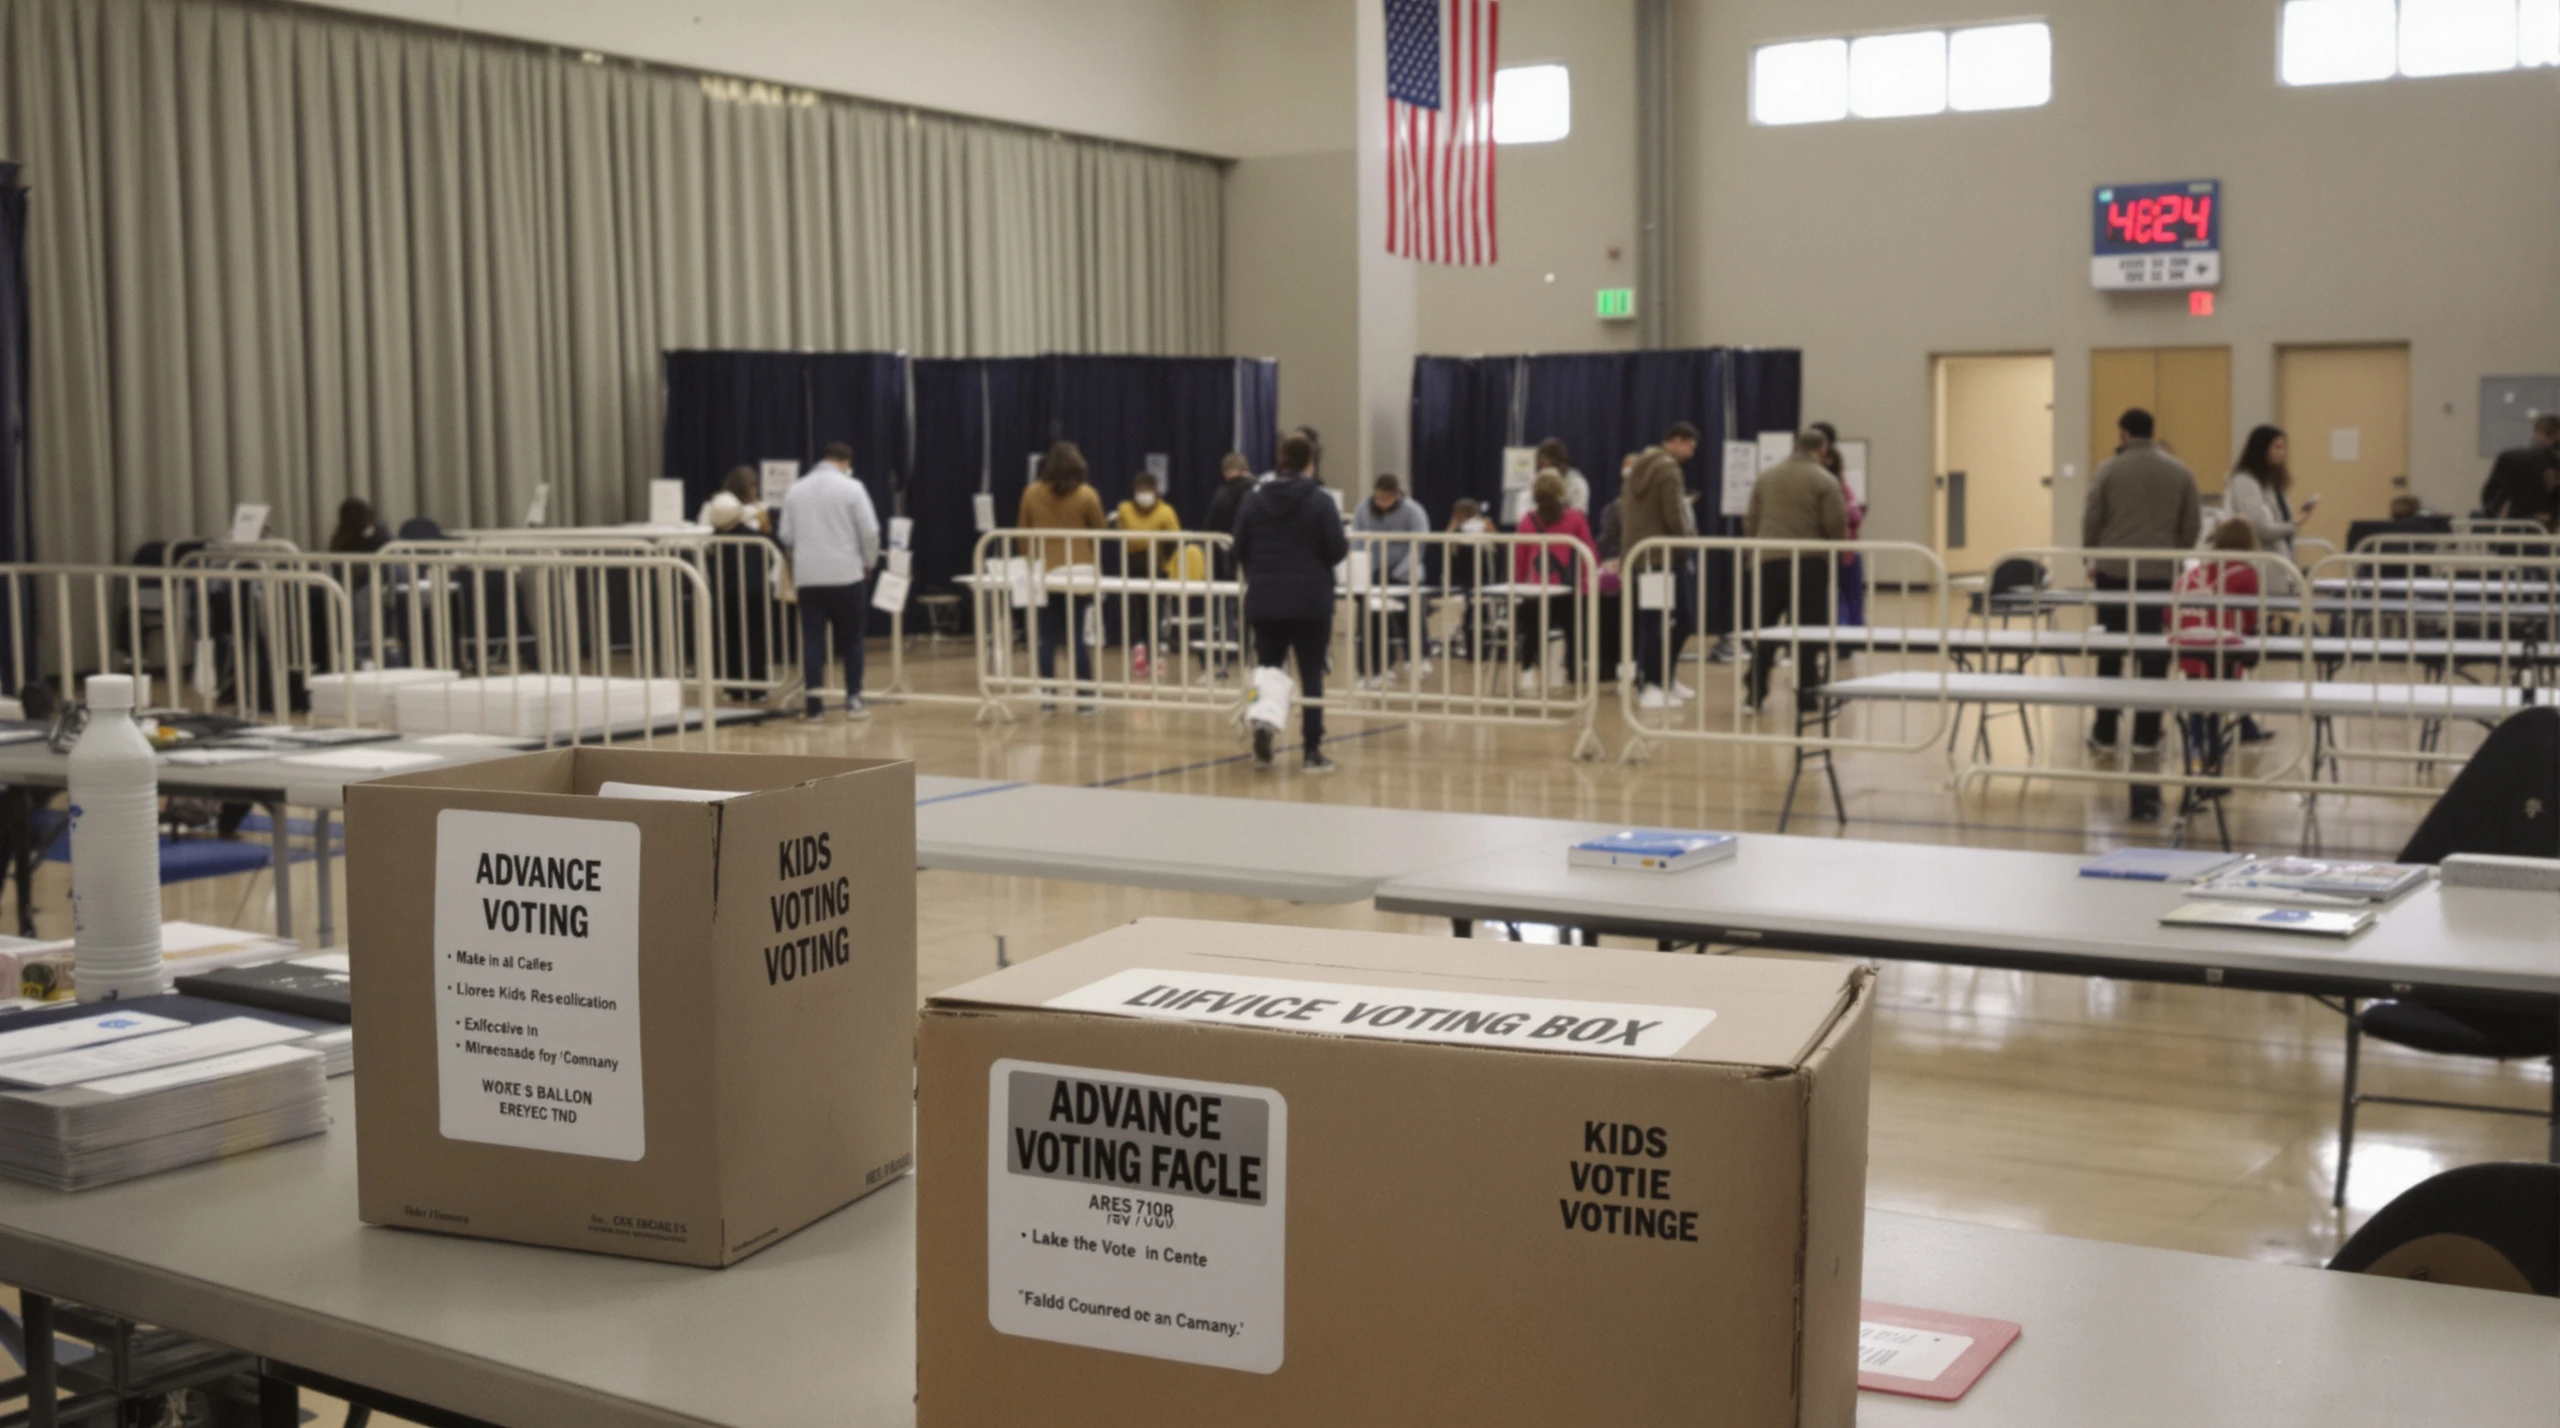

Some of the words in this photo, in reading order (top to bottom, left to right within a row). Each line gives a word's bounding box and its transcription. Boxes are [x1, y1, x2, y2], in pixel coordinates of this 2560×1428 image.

[476, 852, 601, 892] ADVANCE
[779, 832, 831, 881] KIDS
[482, 897, 589, 938] VOTING
[770, 877, 850, 933] VOTING
[764, 926, 850, 986] VOTING
[499, 987, 526, 1001] Kids
[1341, 1003, 1530, 1036] VOTING
[1528, 1014, 1662, 1047] BOX
[537, 1085, 593, 1105] BALLON
[1049, 1079, 1221, 1141] ADVANCE
[1584, 1120, 1668, 1158] KIDS
[1015, 1127, 1141, 1184] VOTING
[1151, 1145, 1261, 1200] FACLE
[1570, 1160, 1670, 1200] VOTIE
[1089, 1194, 1132, 1213] ARES
[1560, 1199, 1698, 1242] VOTINGE
[1032, 1229, 1069, 1249] Lake
[1073, 1235, 1097, 1252] the
[1102, 1240, 1137, 1258] Vote
[1145, 1246, 1159, 1260] in
[1163, 1248, 1208, 1268] Cente
[1154, 1313, 1171, 1326] an
